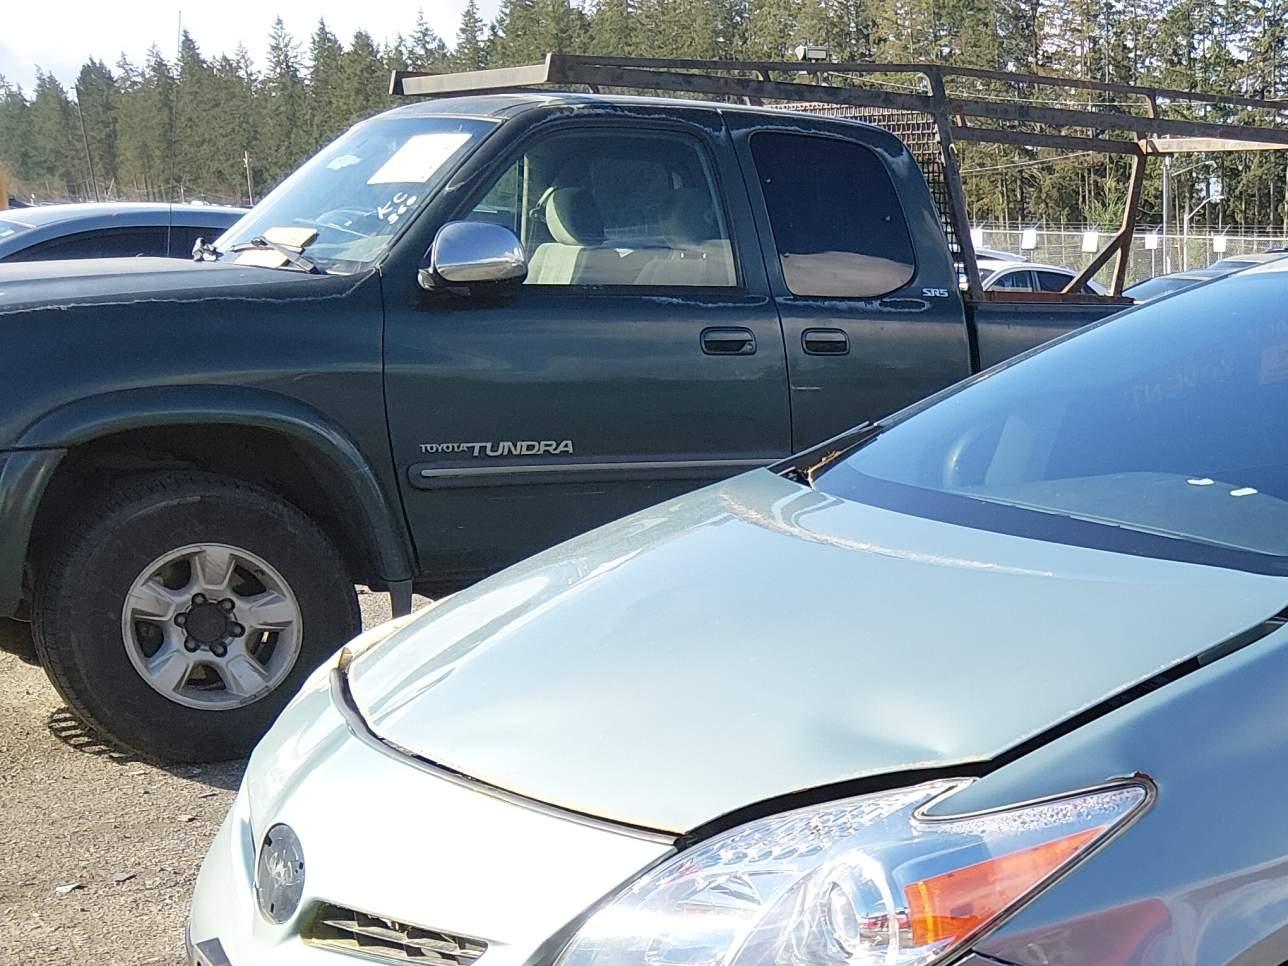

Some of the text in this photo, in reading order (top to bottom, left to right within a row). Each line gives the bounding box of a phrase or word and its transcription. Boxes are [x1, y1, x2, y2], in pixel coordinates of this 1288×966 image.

[922, 288, 949, 297] SR5
[419, 440, 574, 457] TOYOTA TUNDRA
